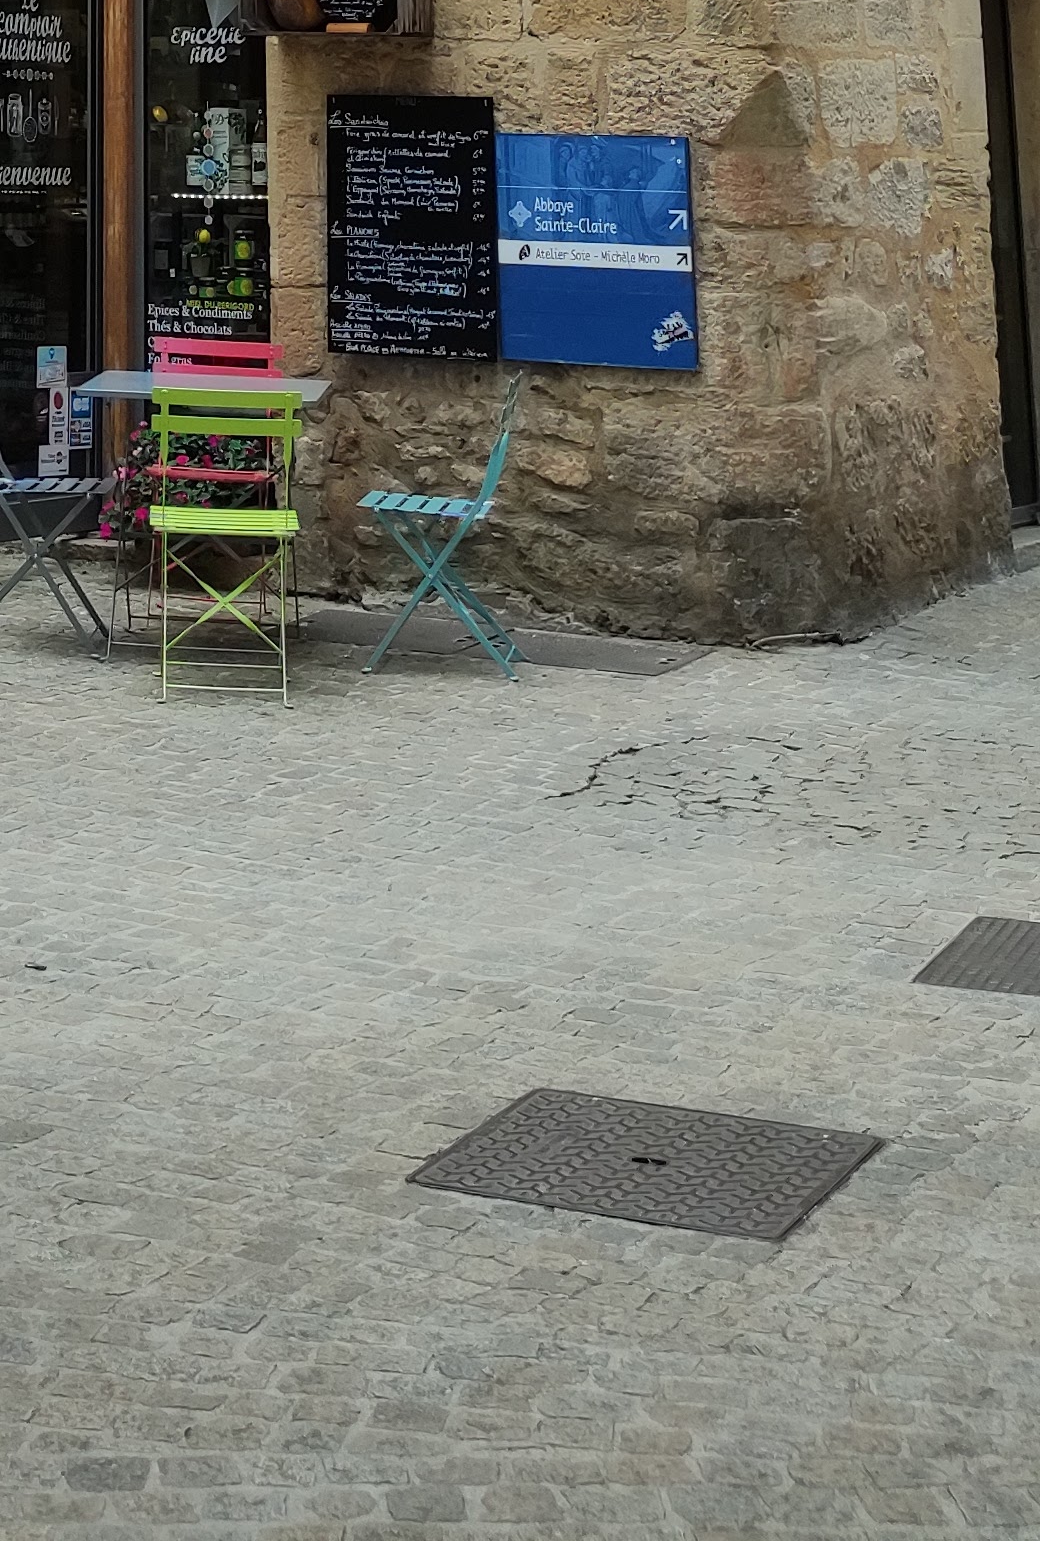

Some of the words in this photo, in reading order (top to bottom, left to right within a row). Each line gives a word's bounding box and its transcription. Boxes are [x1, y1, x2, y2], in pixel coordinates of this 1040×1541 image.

[534, 196, 574, 216] Abbaye
[534, 217, 618, 234] Sainte-Claire
[535, 247, 569, 261] Atelier
[570, 249, 591, 262] Soie
[601, 249, 636, 265] Michèle
[638, 252, 660, 264] Moro
[147, 303, 180, 319] Epices
[181, 304, 191, 317] &
[191, 305, 254, 320] Condiments
[147, 319, 171, 333] Thés
[172, 321, 182, 334] &
[183, 322, 232, 336] Chocolats
